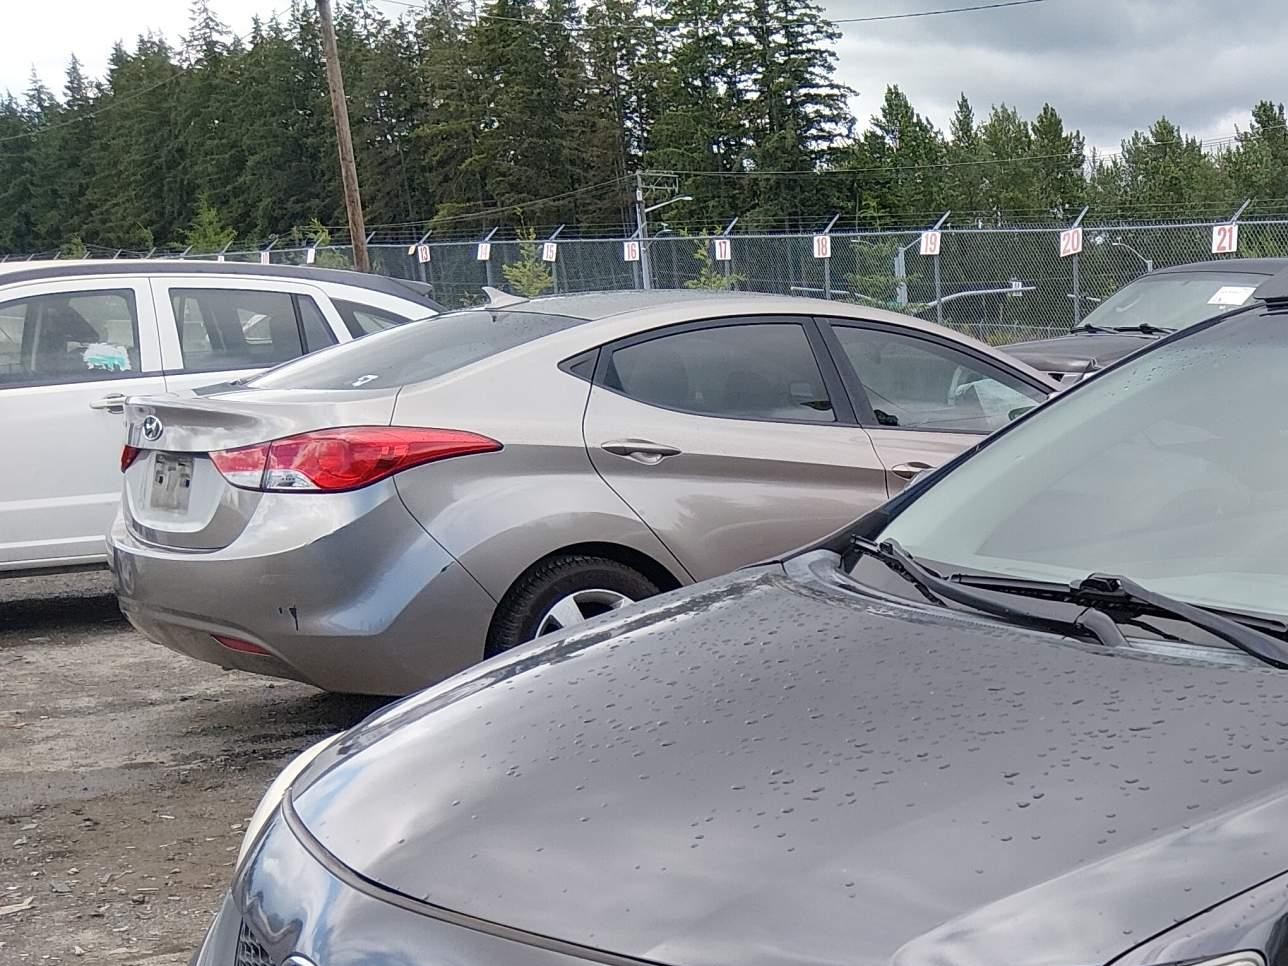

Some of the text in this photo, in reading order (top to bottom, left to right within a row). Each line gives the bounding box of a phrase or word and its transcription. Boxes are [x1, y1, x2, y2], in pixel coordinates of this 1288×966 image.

[718, 240, 728, 259] 17
[816, 236, 828, 257] 18
[924, 232, 938, 253] 19
[1062, 230, 1081, 255] 20
[1216, 226, 1233, 252] 21
[546, 244, 555, 260] 15
[626, 243, 637, 260] 16
